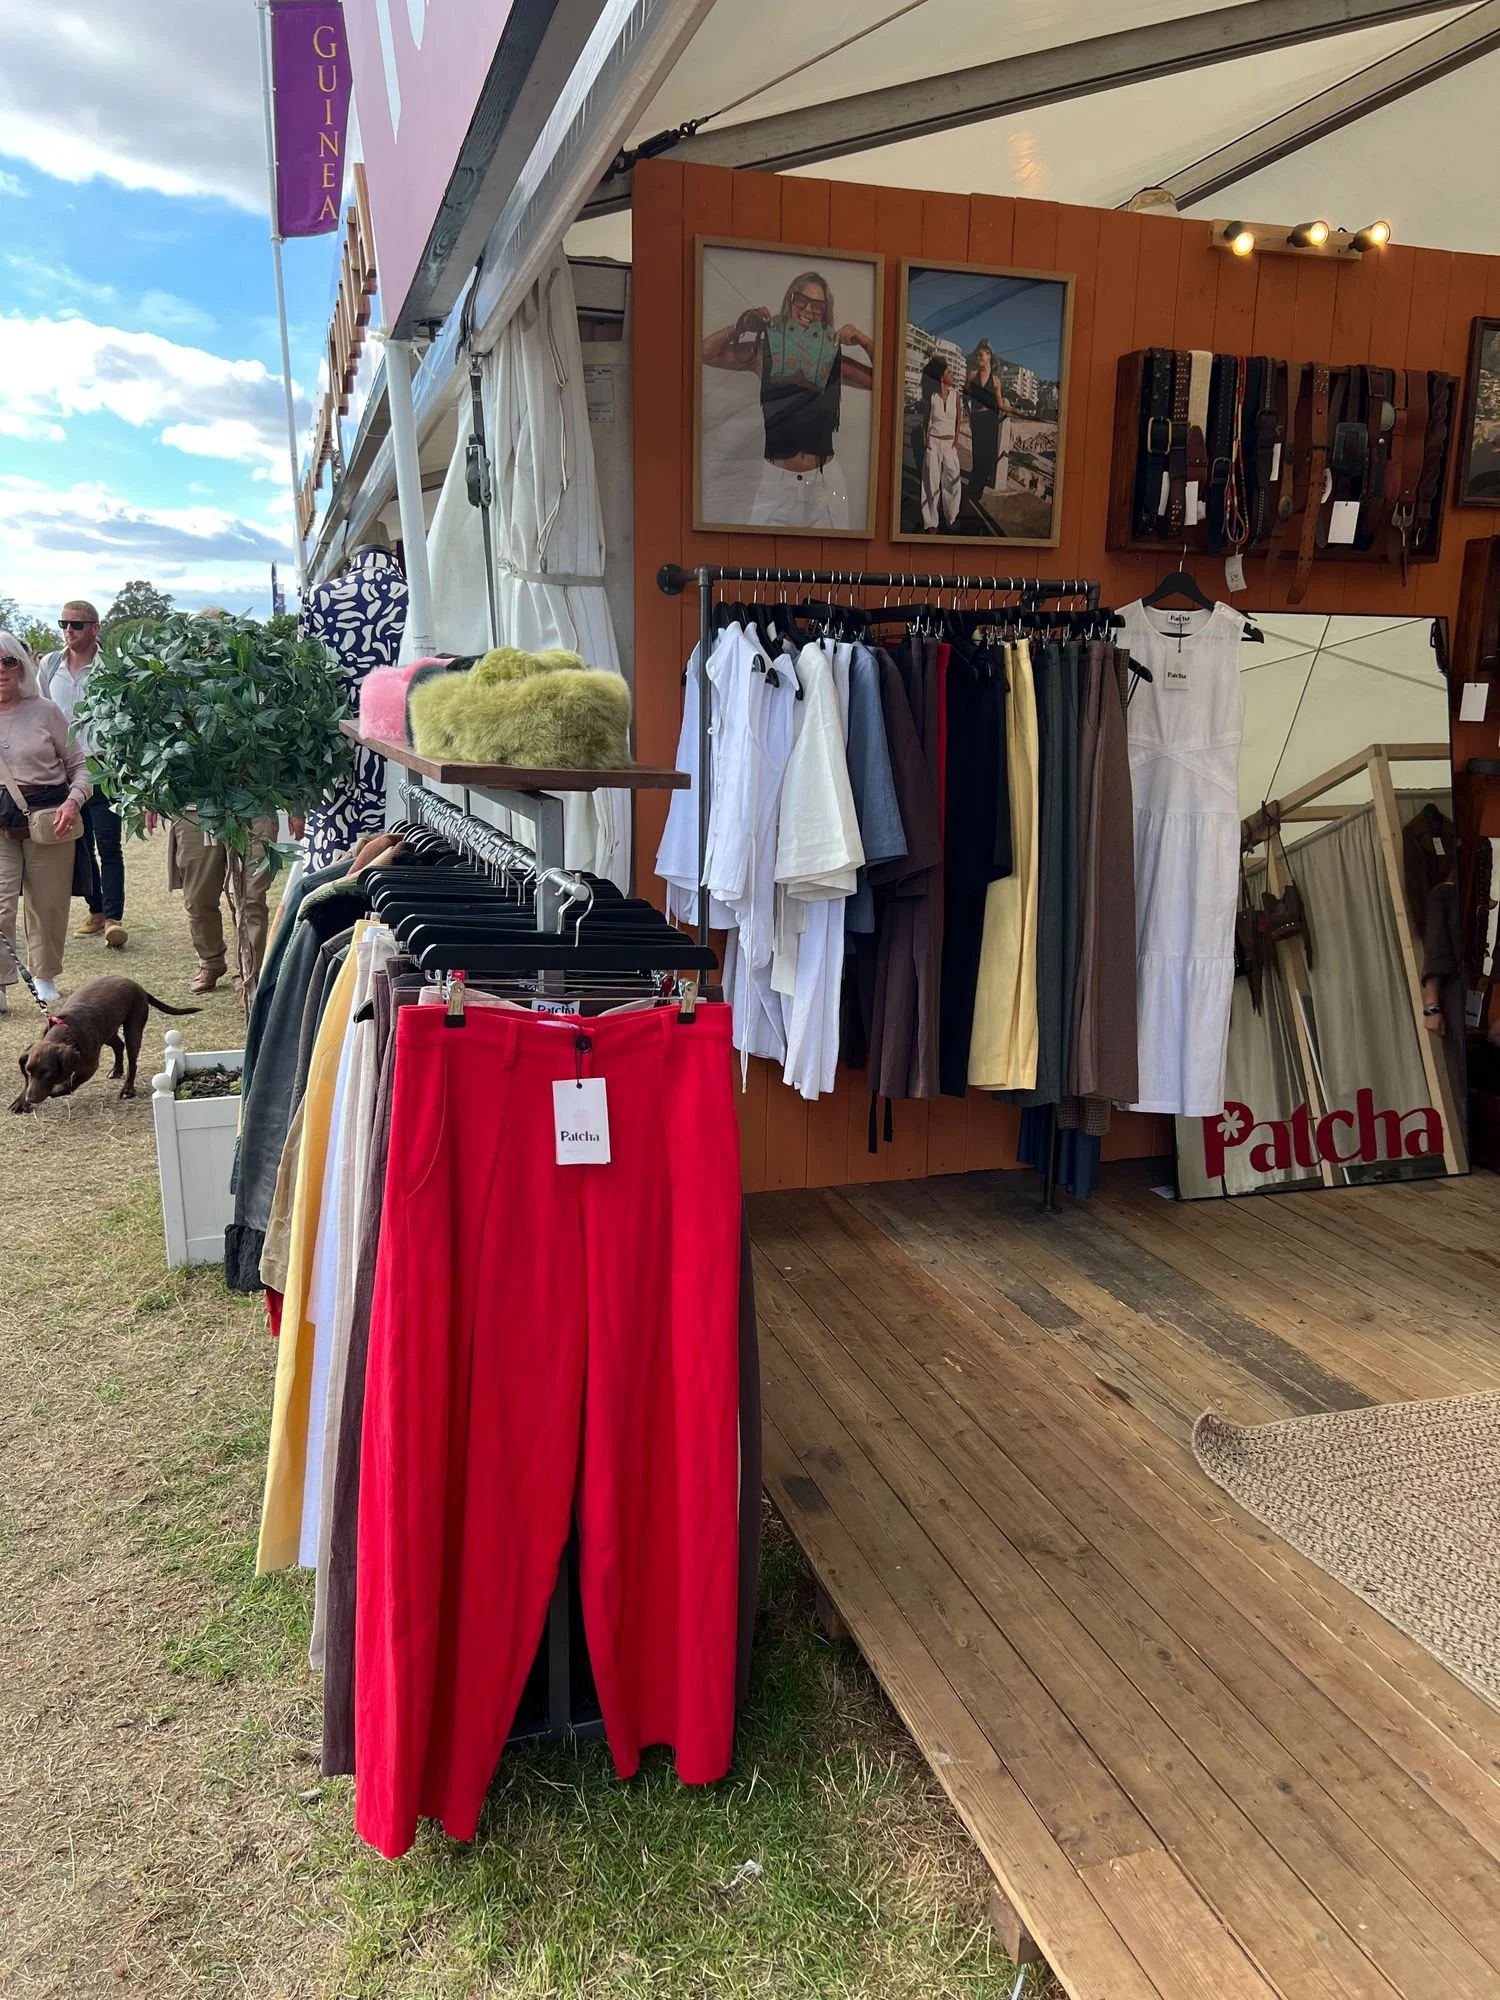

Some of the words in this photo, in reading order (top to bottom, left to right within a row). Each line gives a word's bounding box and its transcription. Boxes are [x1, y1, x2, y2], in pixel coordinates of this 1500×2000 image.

[312, 25, 340, 221] GUINEA
[560, 1130, 600, 1142] Patcha
[1202, 1087, 1445, 1179] Patcha
